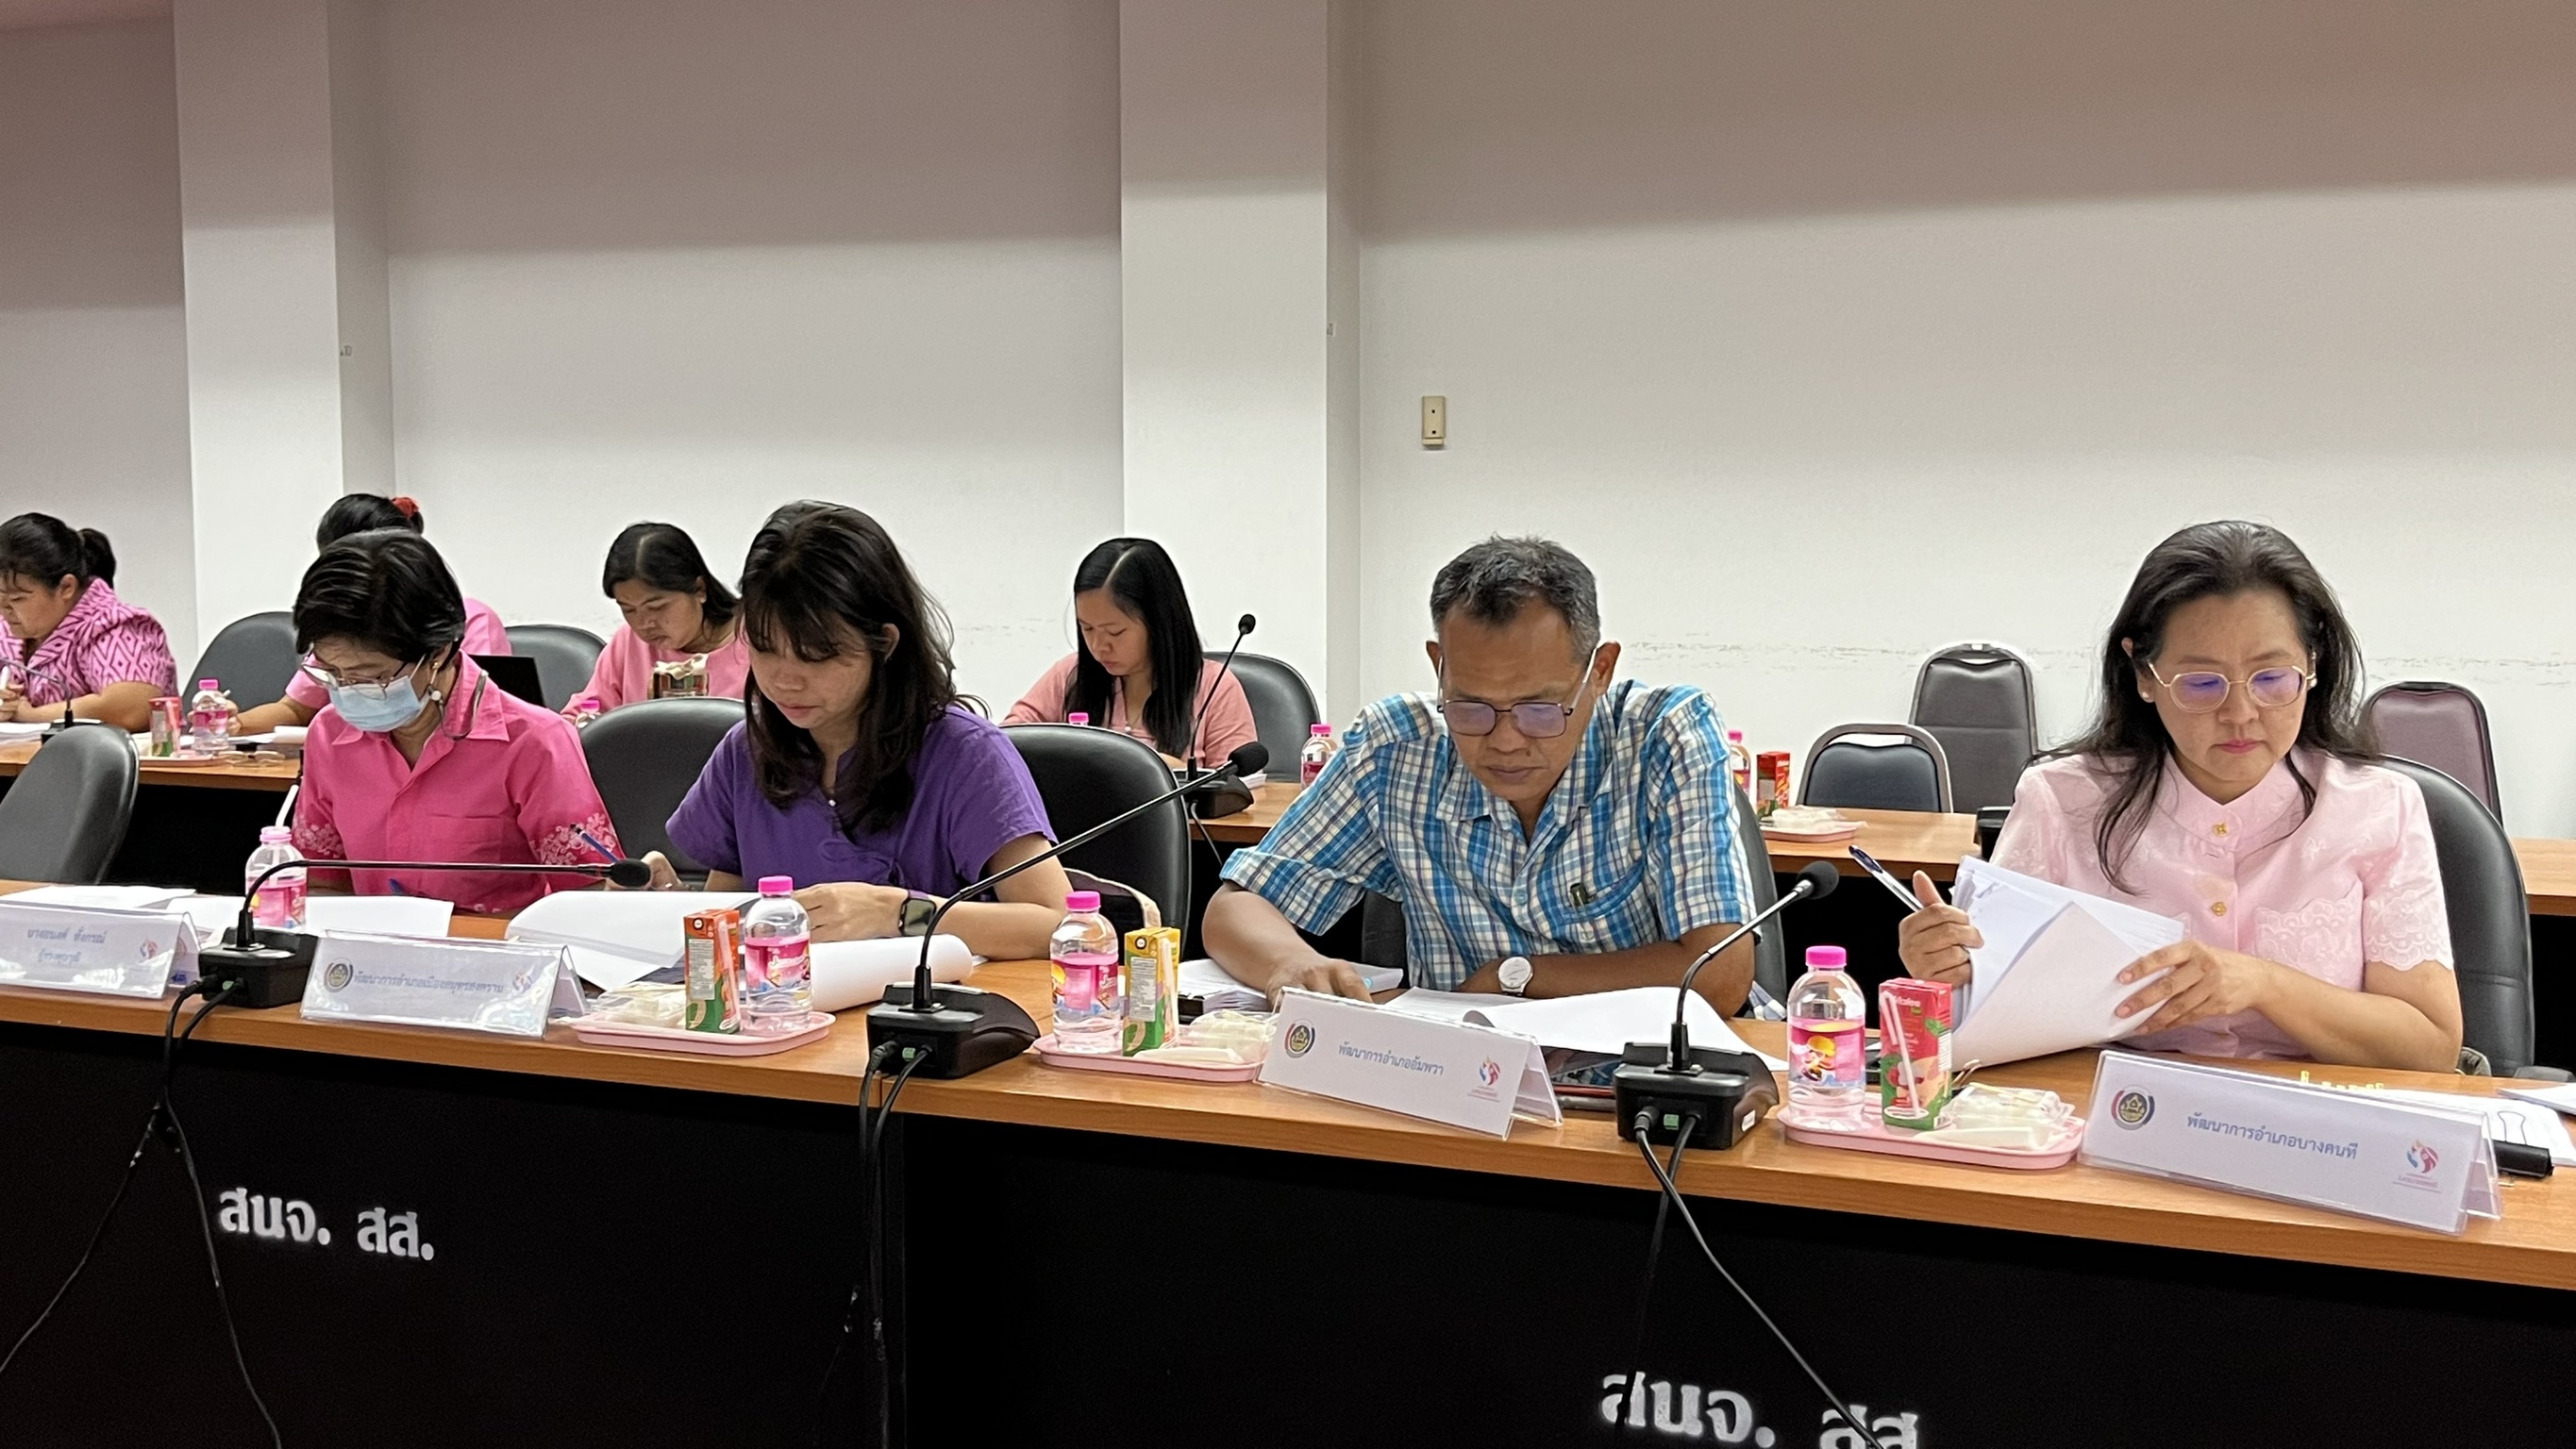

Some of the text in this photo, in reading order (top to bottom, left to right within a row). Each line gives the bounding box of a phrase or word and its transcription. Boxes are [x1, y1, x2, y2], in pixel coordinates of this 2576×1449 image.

[1338, 1041, 1445, 1076] พัฒนาการอำเภออัมพวา
[2186, 1111, 2359, 1160] พัฒนาการอำเภอบางคนที
[219, 1187, 435, 1261] สนจ. สส.
[1600, 1371, 1776, 1449] สนจ.
